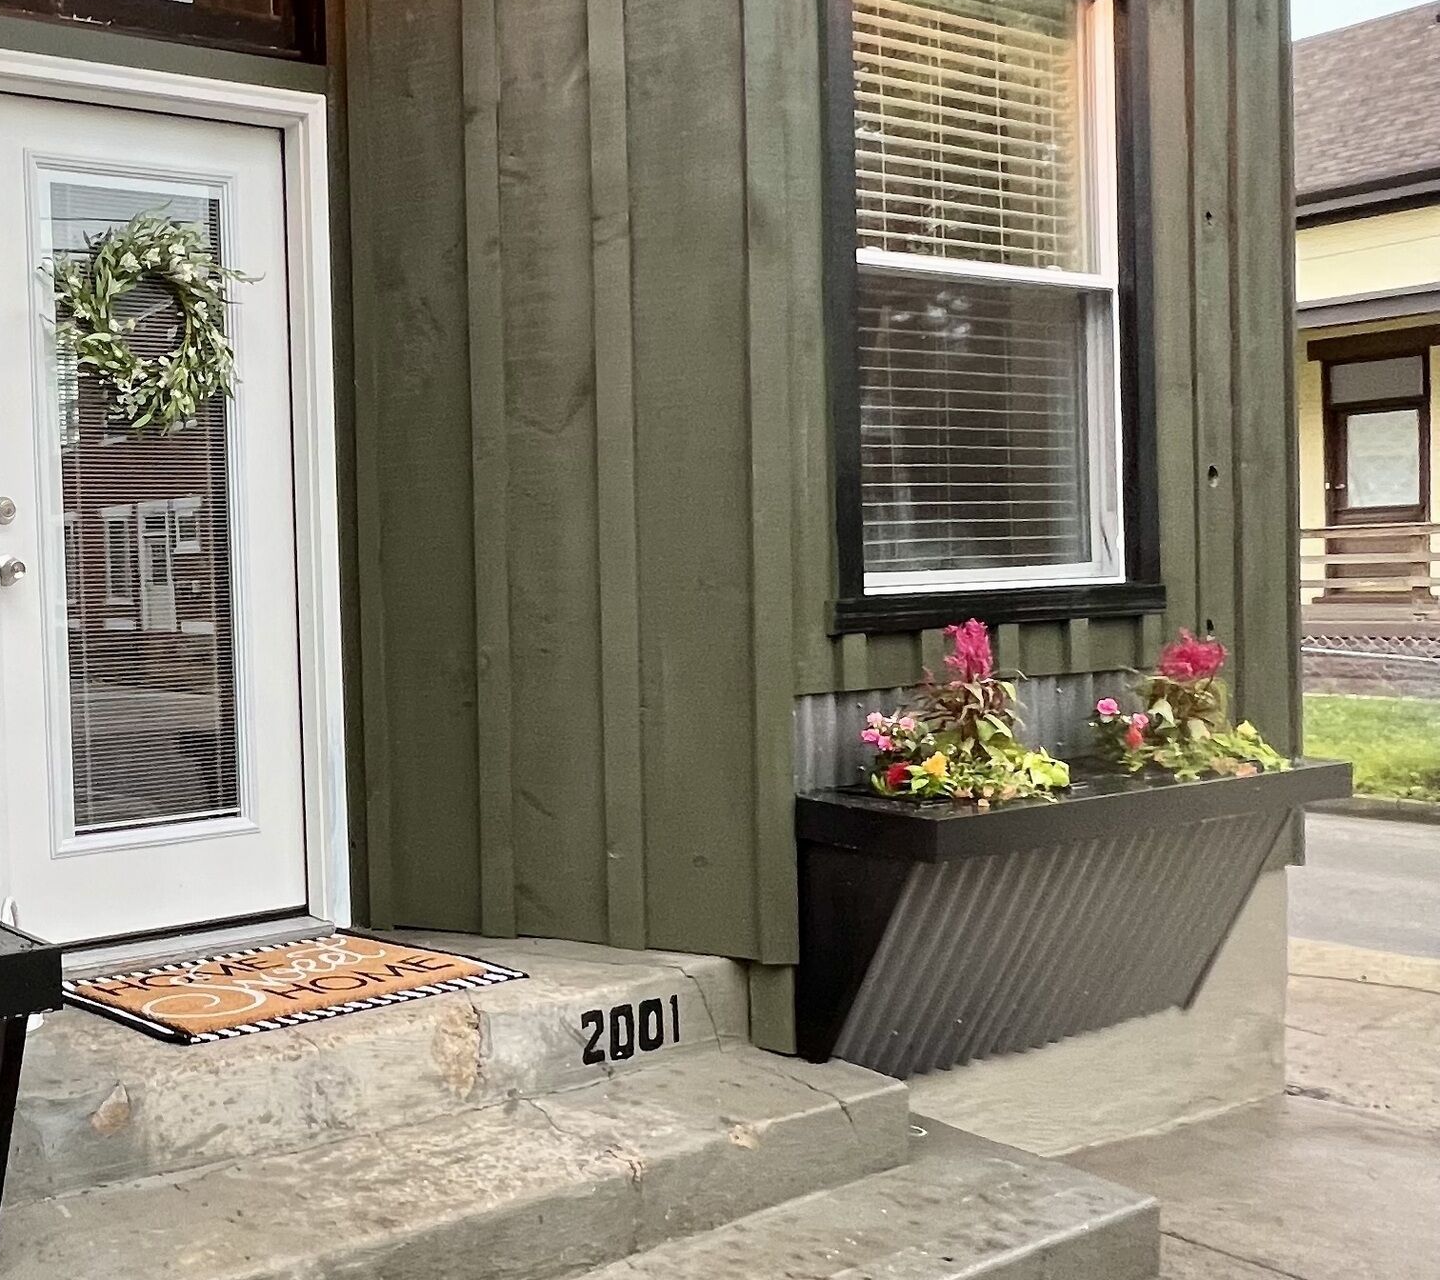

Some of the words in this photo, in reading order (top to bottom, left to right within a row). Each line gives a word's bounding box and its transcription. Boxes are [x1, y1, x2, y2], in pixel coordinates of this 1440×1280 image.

[92, 956, 284, 997] HOME
[141, 937, 386, 1019] Sweet
[262, 954, 455, 1000] HOME
[580, 994, 680, 1065] 2001
